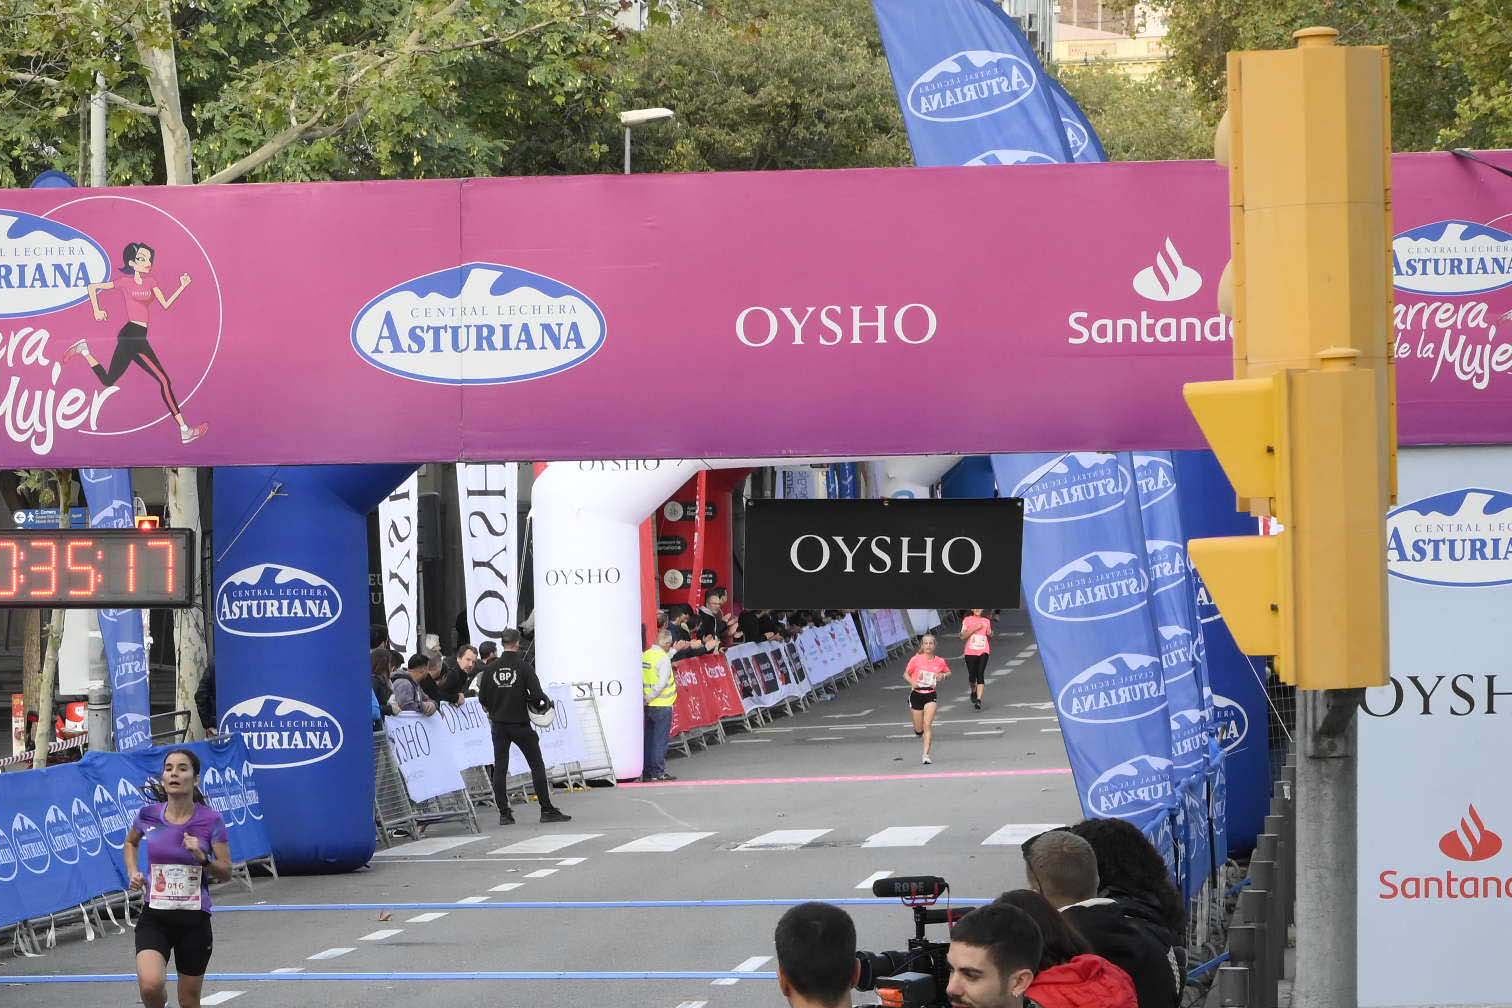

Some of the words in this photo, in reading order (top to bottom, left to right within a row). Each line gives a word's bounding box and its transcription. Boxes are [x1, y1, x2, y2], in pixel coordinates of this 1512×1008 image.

[14, 246, 87, 256] LECHERA
[1407, 245, 1459, 255] CENTRAL
[1464, 243, 1512, 254] LECHER
[411, 305, 488, 319] CENTRAL
[497, 304, 577, 317] LECHERA
[1393, 301, 1488, 330] arrera
[371, 310, 586, 353] ASTURIANA
[735, 303, 937, 347] OYSHO
[1068, 311, 1235, 344] Santand
[1417, 331, 1434, 360] la
[1430, 325, 1512, 390] Muje
[1415, 523, 1481, 533] CENTRAL
[790, 534, 982, 575] OYSHO
[546, 567, 621, 586] OYSHO
[232, 589, 275, 598] CENTRAL
[279, 588, 328, 597] LECHERA
[220, 593, 333, 621] ASTURIANA
[499, 672, 511, 681] BP
[575, 679, 622, 697] SHO
[1358, 674, 1512, 717] OYSH
[234, 720, 275, 729] CENTRAL
[280, 720, 329, 728] LECHERA
